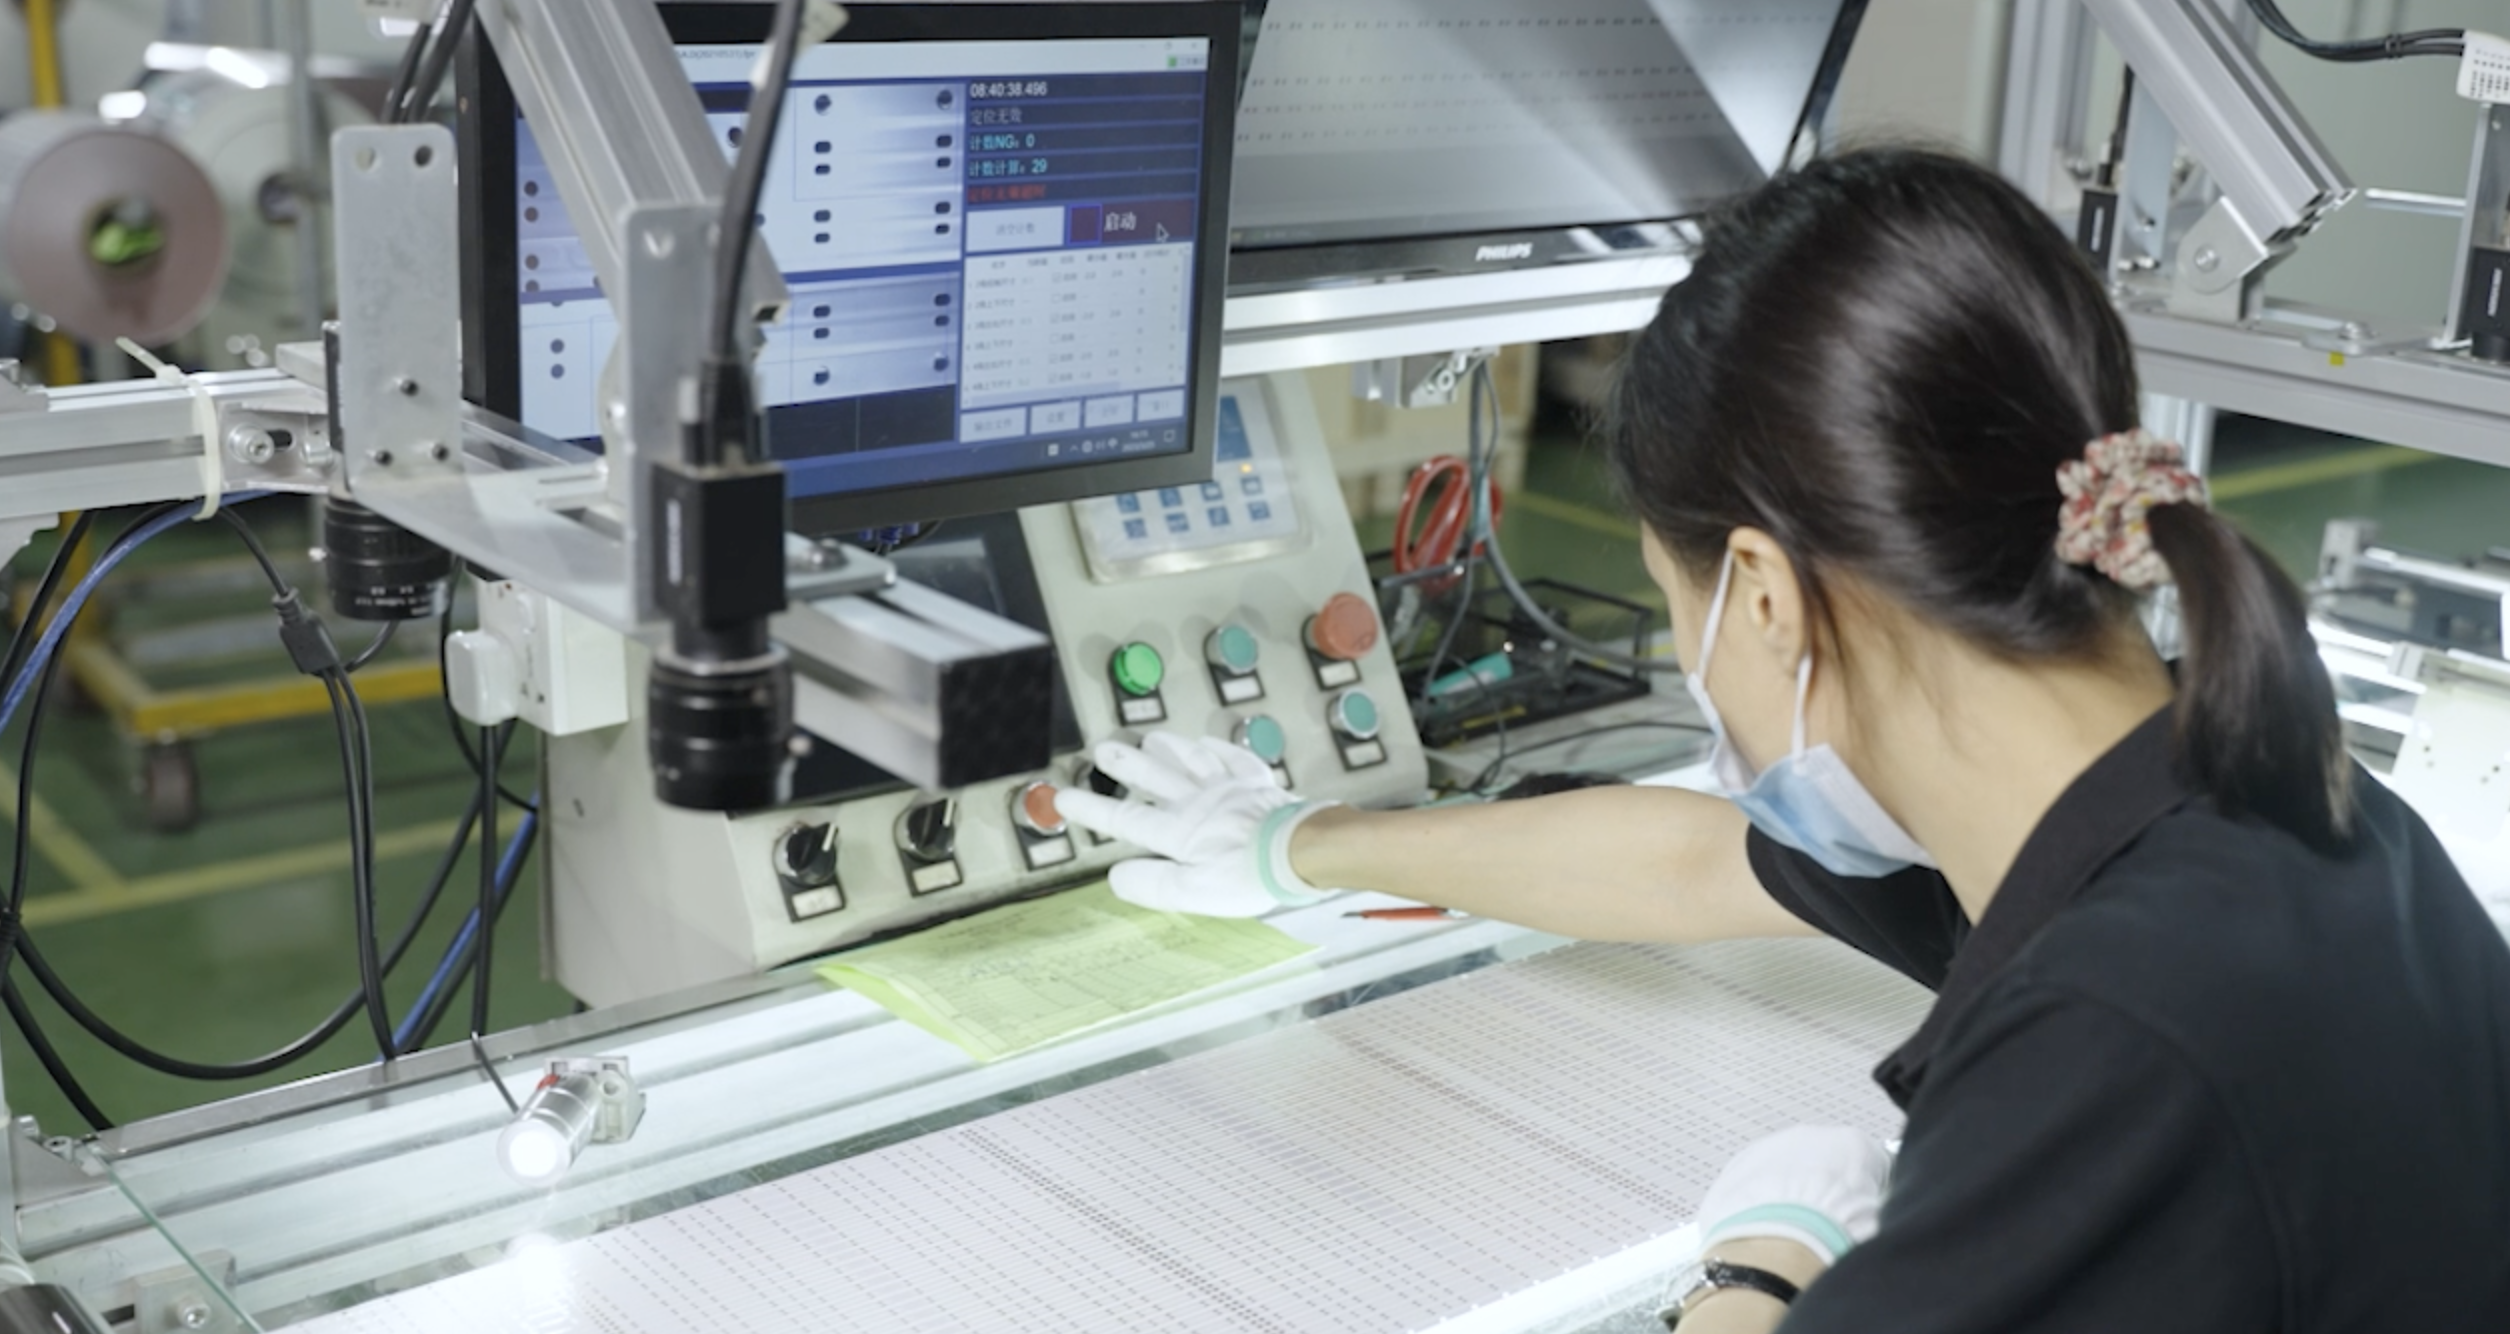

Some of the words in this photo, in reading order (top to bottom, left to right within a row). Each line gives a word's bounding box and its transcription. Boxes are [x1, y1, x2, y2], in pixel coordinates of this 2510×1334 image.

[970, 81, 1047, 98] 08:40:38.496
[970, 107, 1023, 125] 定位无效
[1104, 211, 1137, 232] 启动
[1475, 242, 1534, 262] PHILIPS
